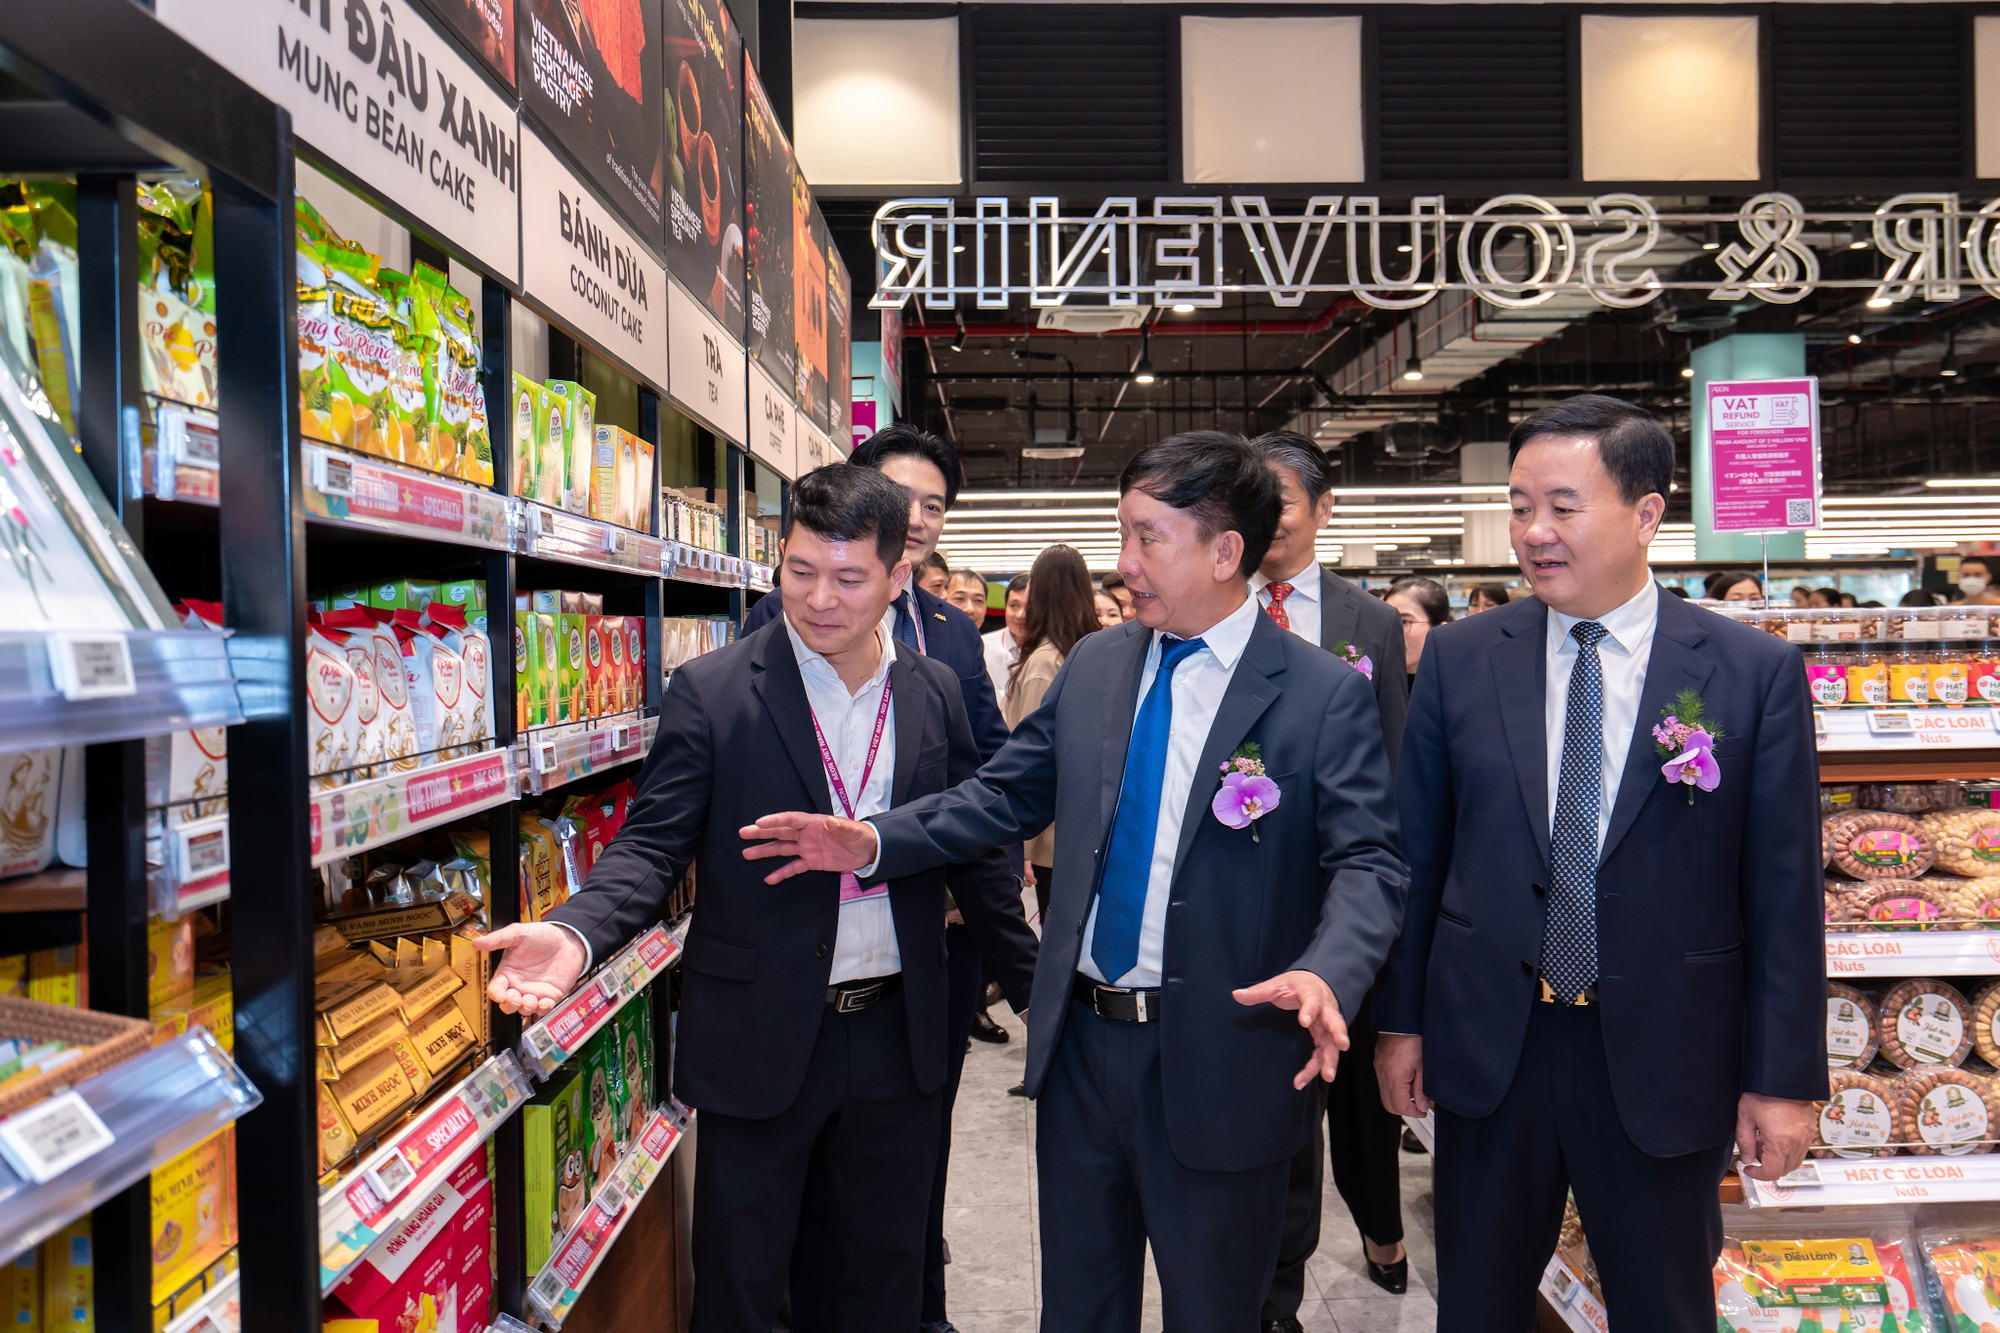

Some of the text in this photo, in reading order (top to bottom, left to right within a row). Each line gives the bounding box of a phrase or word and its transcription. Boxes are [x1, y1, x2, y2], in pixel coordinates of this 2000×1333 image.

[484, 2, 504, 40] today
[530, 11, 594, 99] VIETNAMESE
[531, 36, 582, 107] HERITAGE
[532, 61, 573, 117] PASTRY
[278, 25, 476, 214] MUNG BEAN CAKE
[436, 69, 516, 193] XANH
[670, 202, 698, 244] SPECIALTY
[671, 184, 702, 235] VIETNAMESE
[671, 219, 684, 244] TEA
[558, 190, 612, 280] BÁNH
[615, 244, 649, 312] DỪA
[569, 263, 644, 345] COCONUT CAKE
[702, 332, 724, 379] TRÀ
[708, 379, 720, 406] TEA
[1723, 397, 1790, 411] VAT VAT
[1722, 411, 1761, 420] REFUND
[1725, 421, 1756, 429] SERVICE
[423, 494, 462, 522] SPECIALTY
[1948, 716, 1985, 731] LOẠI
[1920, 733, 1951, 744] Nuts
[827, 762, 839, 781] AEON
[408, 776, 452, 815] VIETNAM
[378, 917, 402, 928] MINH
[405, 911, 433, 922] NGỌC
[1825, 940, 1902, 957] CÁC LOẠI
[1833, 960, 1866, 972] Nuts
[425, 1021, 466, 1057] MINH NGỌC
[351, 1073, 402, 1115] MINH NGỌC
[427, 1107, 470, 1152] SPECIALTY
[1844, 1168, 1879, 1184] HẠT
[1920, 1165, 1964, 1183] LOẠI
[1895, 1185, 1929, 1198] Nuts
[386, 1236, 404, 1256] RỒNG
[402, 1218, 420, 1241] VÀNG
[417, 1202, 438, 1230] HOÀNG
[434, 1193, 447, 1210] GIA
[1784, 1251, 1838, 1262] Điều Lành
[1581, 1298, 1599, 1321] HẠT
[1748, 1306, 1780, 1320] Vỏ Lụa
